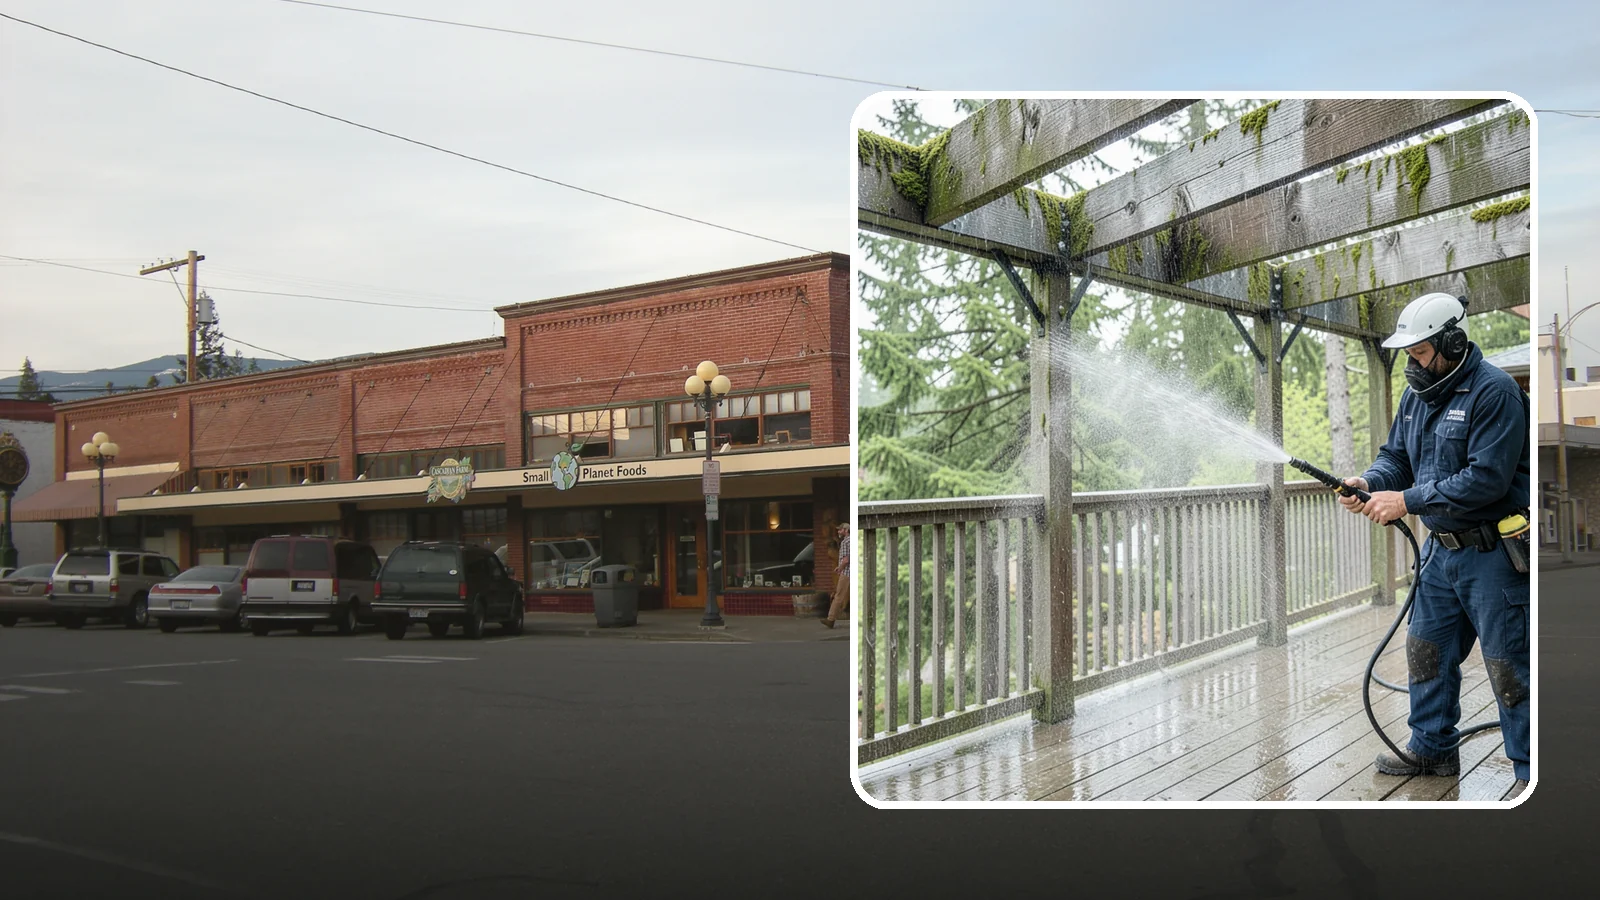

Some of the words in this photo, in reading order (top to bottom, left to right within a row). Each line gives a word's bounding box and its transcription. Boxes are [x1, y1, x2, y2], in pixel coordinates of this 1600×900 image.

[522, 471, 549, 483] Small
[582, 466, 614, 479] Planet
[616, 464, 647, 476] Foods
